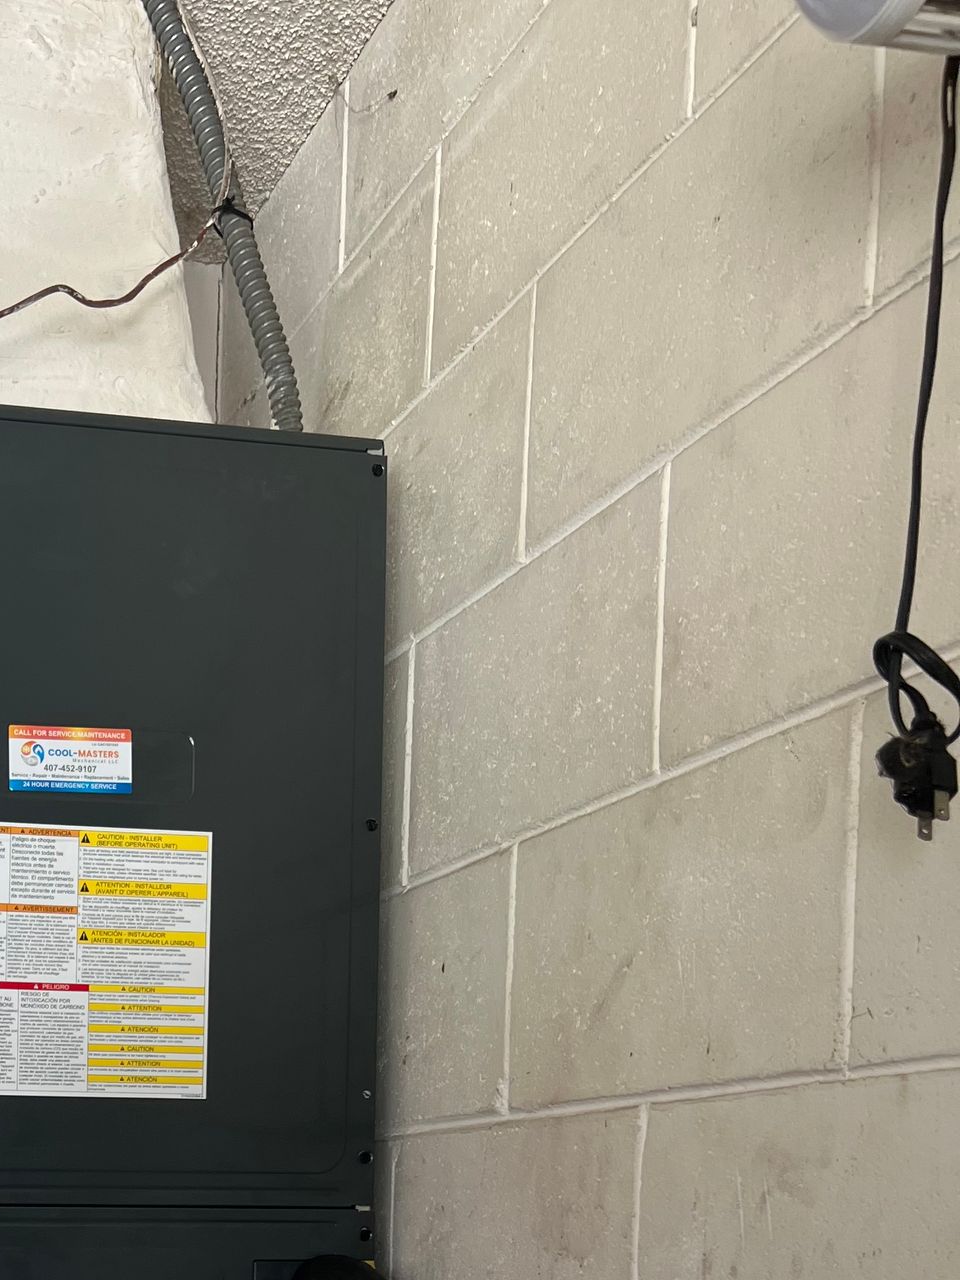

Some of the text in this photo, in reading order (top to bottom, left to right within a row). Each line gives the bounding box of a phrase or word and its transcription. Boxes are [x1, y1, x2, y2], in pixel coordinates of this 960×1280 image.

[48, 749, 120, 758] COOL-MASTERS
[44, 764, 97, 773] 407-452-9107
[124, 841, 161, 849] OPERATING
[152, 890, 188, 898] L'APPAREIL)
